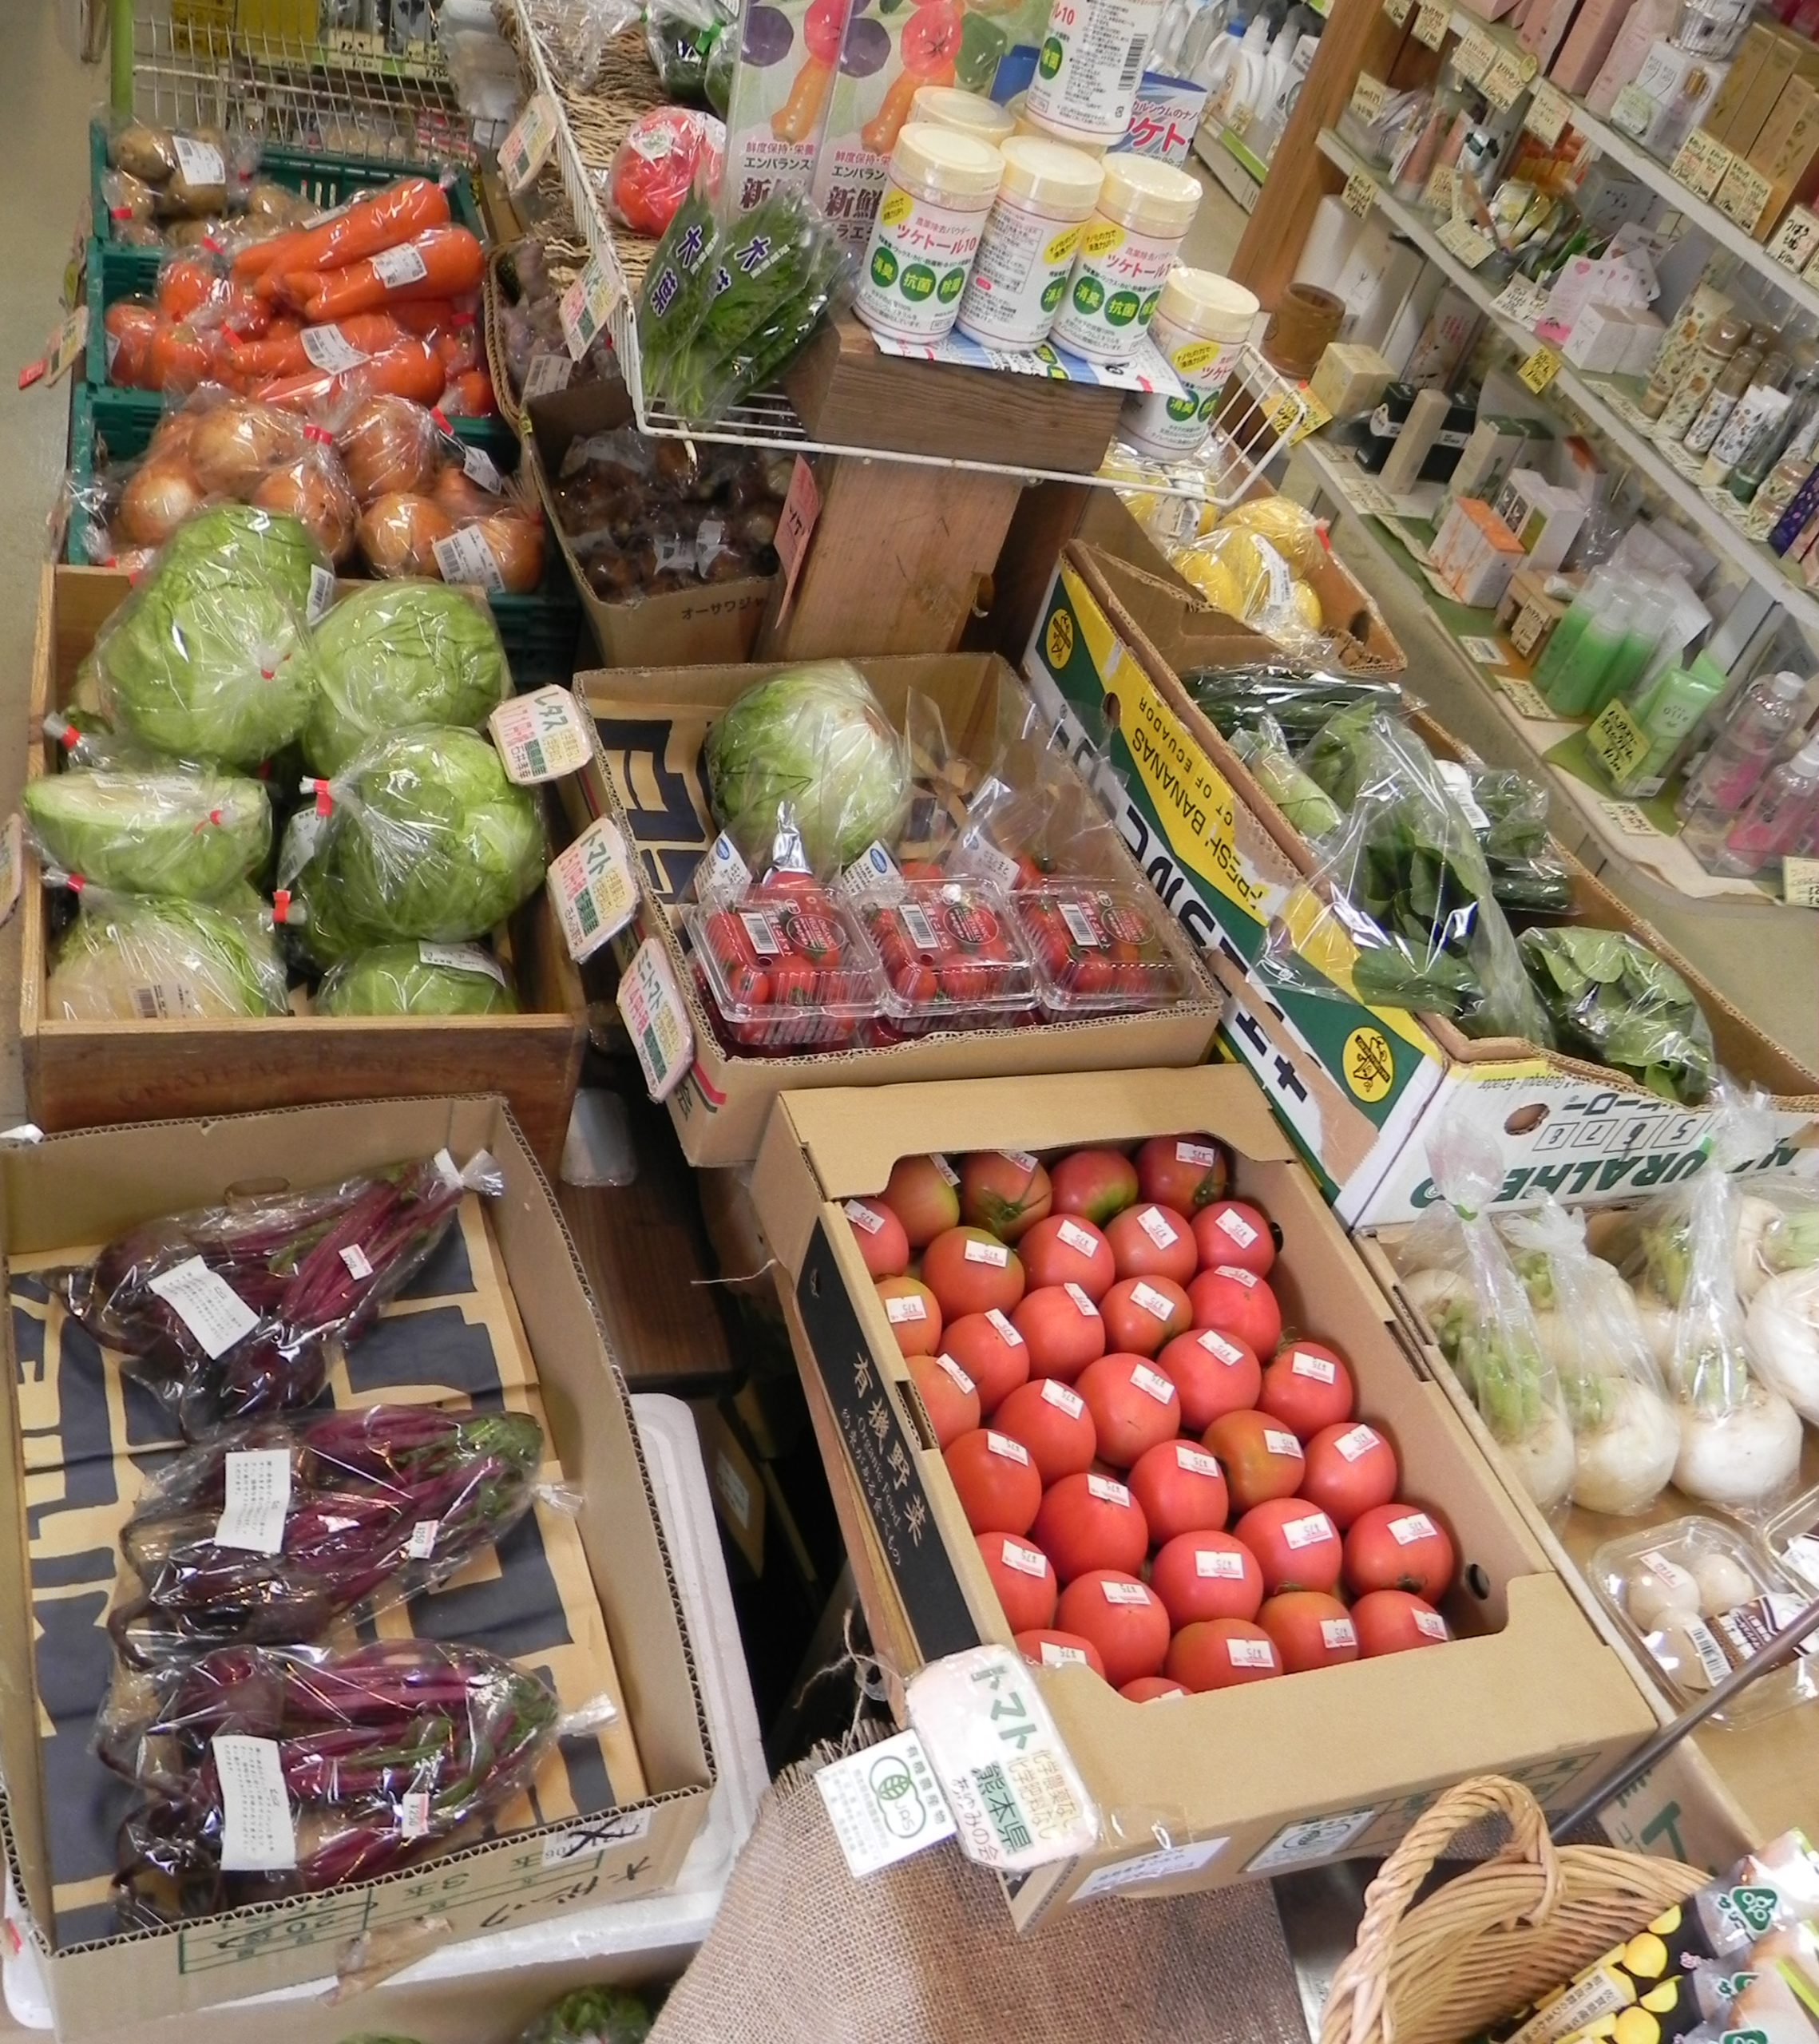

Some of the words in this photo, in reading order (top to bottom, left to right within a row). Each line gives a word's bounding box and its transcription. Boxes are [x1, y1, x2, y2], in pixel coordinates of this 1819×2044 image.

[743, 156, 813, 171] エンバランス
[831, 165, 887, 181] エンバラン
[897, 224, 977, 256] ツケトール10
[903, 272, 933, 293] 抗菌
[1108, 300, 1137, 319] 抗菌
[534, 692, 570, 731] レタス
[1138, 695, 1194, 772] ECUADOR
[1131, 727, 1207, 836] BANANAS
[1195, 778, 1213, 798] OF
[580, 827, 612, 875] トマト
[637, 949, 662, 1012] ミニトマト
[1477, 1077, 1516, 1091] Ecuador
[1548, 1127, 1565, 1145] 8
[1585, 1124, 1603, 1142] 7
[1670, 1119, 1696, 1142] 5
[851, 1352, 926, 1548] 有機野菜
[414, 1526, 426, 1544] ¥250
[970, 1666, 1037, 1749] トマト
[906, 1744, 947, 1826] 有機農産物
[1007, 1757, 1054, 1840] 化学肥料なし
[1030, 1749, 1081, 1828] 化学農薬なし
[408, 1804, 419, 1827] ¥250
[894, 1800, 917, 1832] JAS
